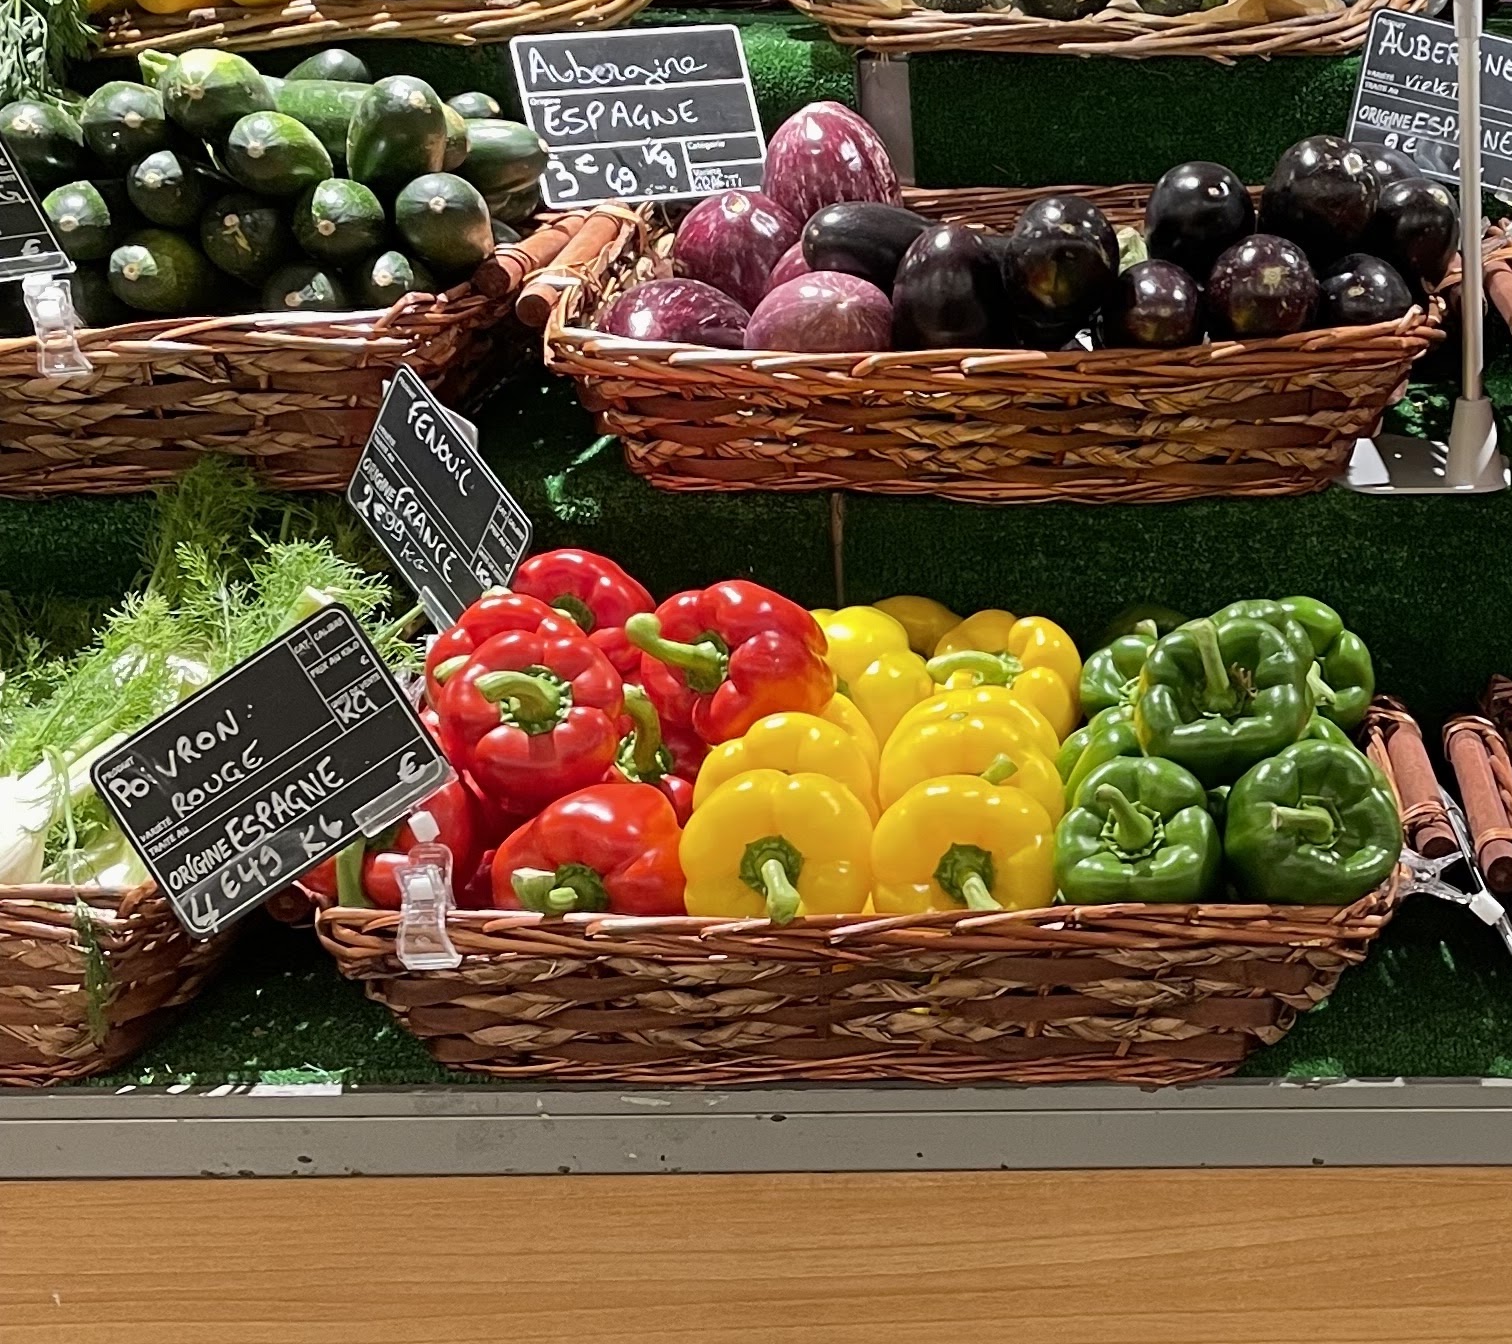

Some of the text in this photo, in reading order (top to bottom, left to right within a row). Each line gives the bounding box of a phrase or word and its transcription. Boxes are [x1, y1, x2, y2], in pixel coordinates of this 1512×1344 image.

[544, 99, 698, 136] ESPAGNE
[1358, 105, 1411, 131] ORIGINE
[394, 486, 458, 584] FRANCE
[171, 739, 263, 819] ROUGE
[168, 756, 345, 891] ORIGINE ESPAGNE
